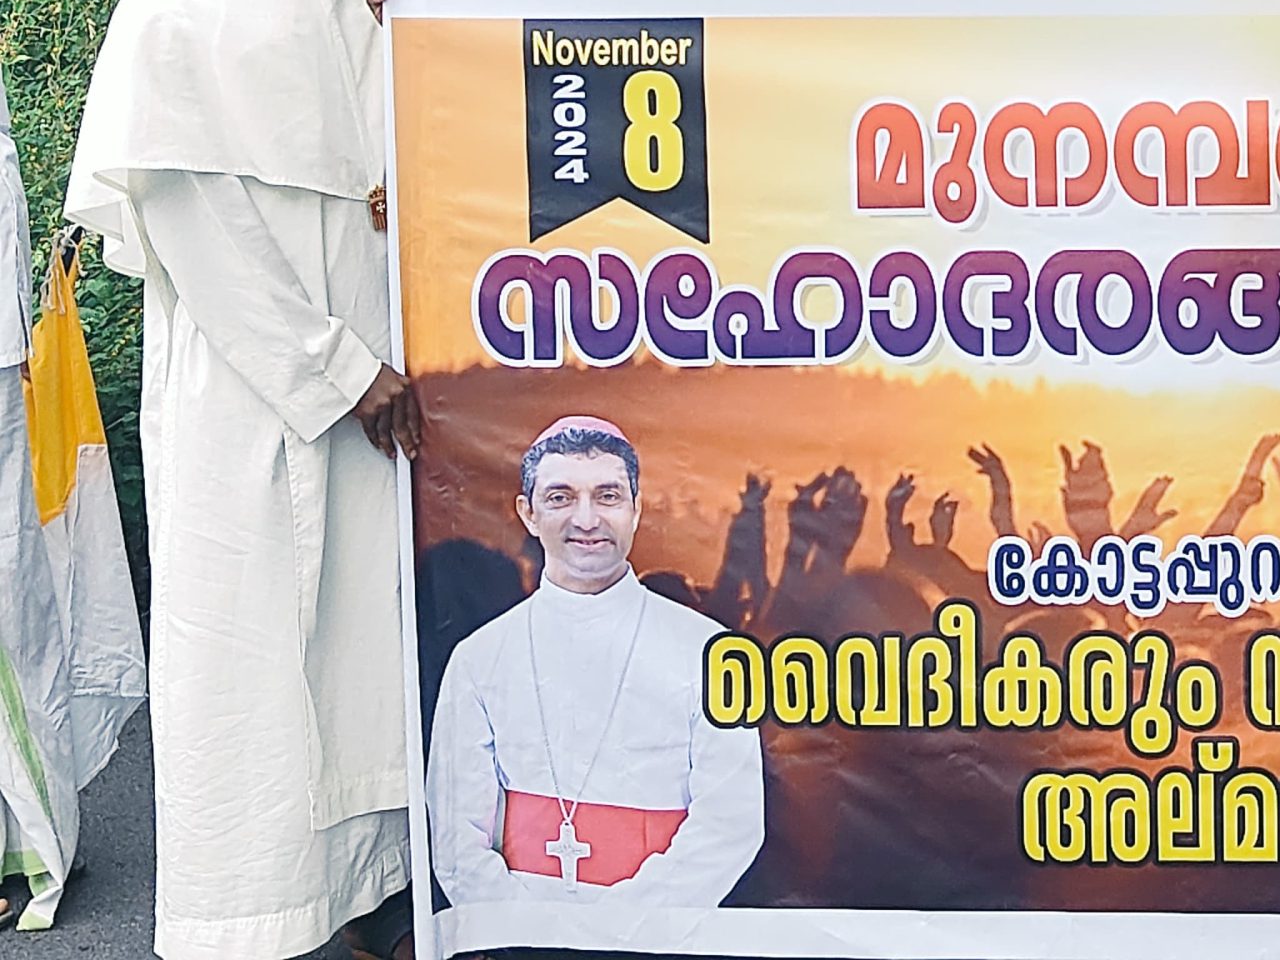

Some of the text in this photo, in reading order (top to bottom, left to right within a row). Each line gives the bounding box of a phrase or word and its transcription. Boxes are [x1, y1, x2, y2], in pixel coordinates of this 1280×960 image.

[531, 29, 693, 67] November
[551, 73, 590, 185] 2024
[621, 68, 686, 193] 8
[705, 602, 1218, 754] വൈദീകരും
